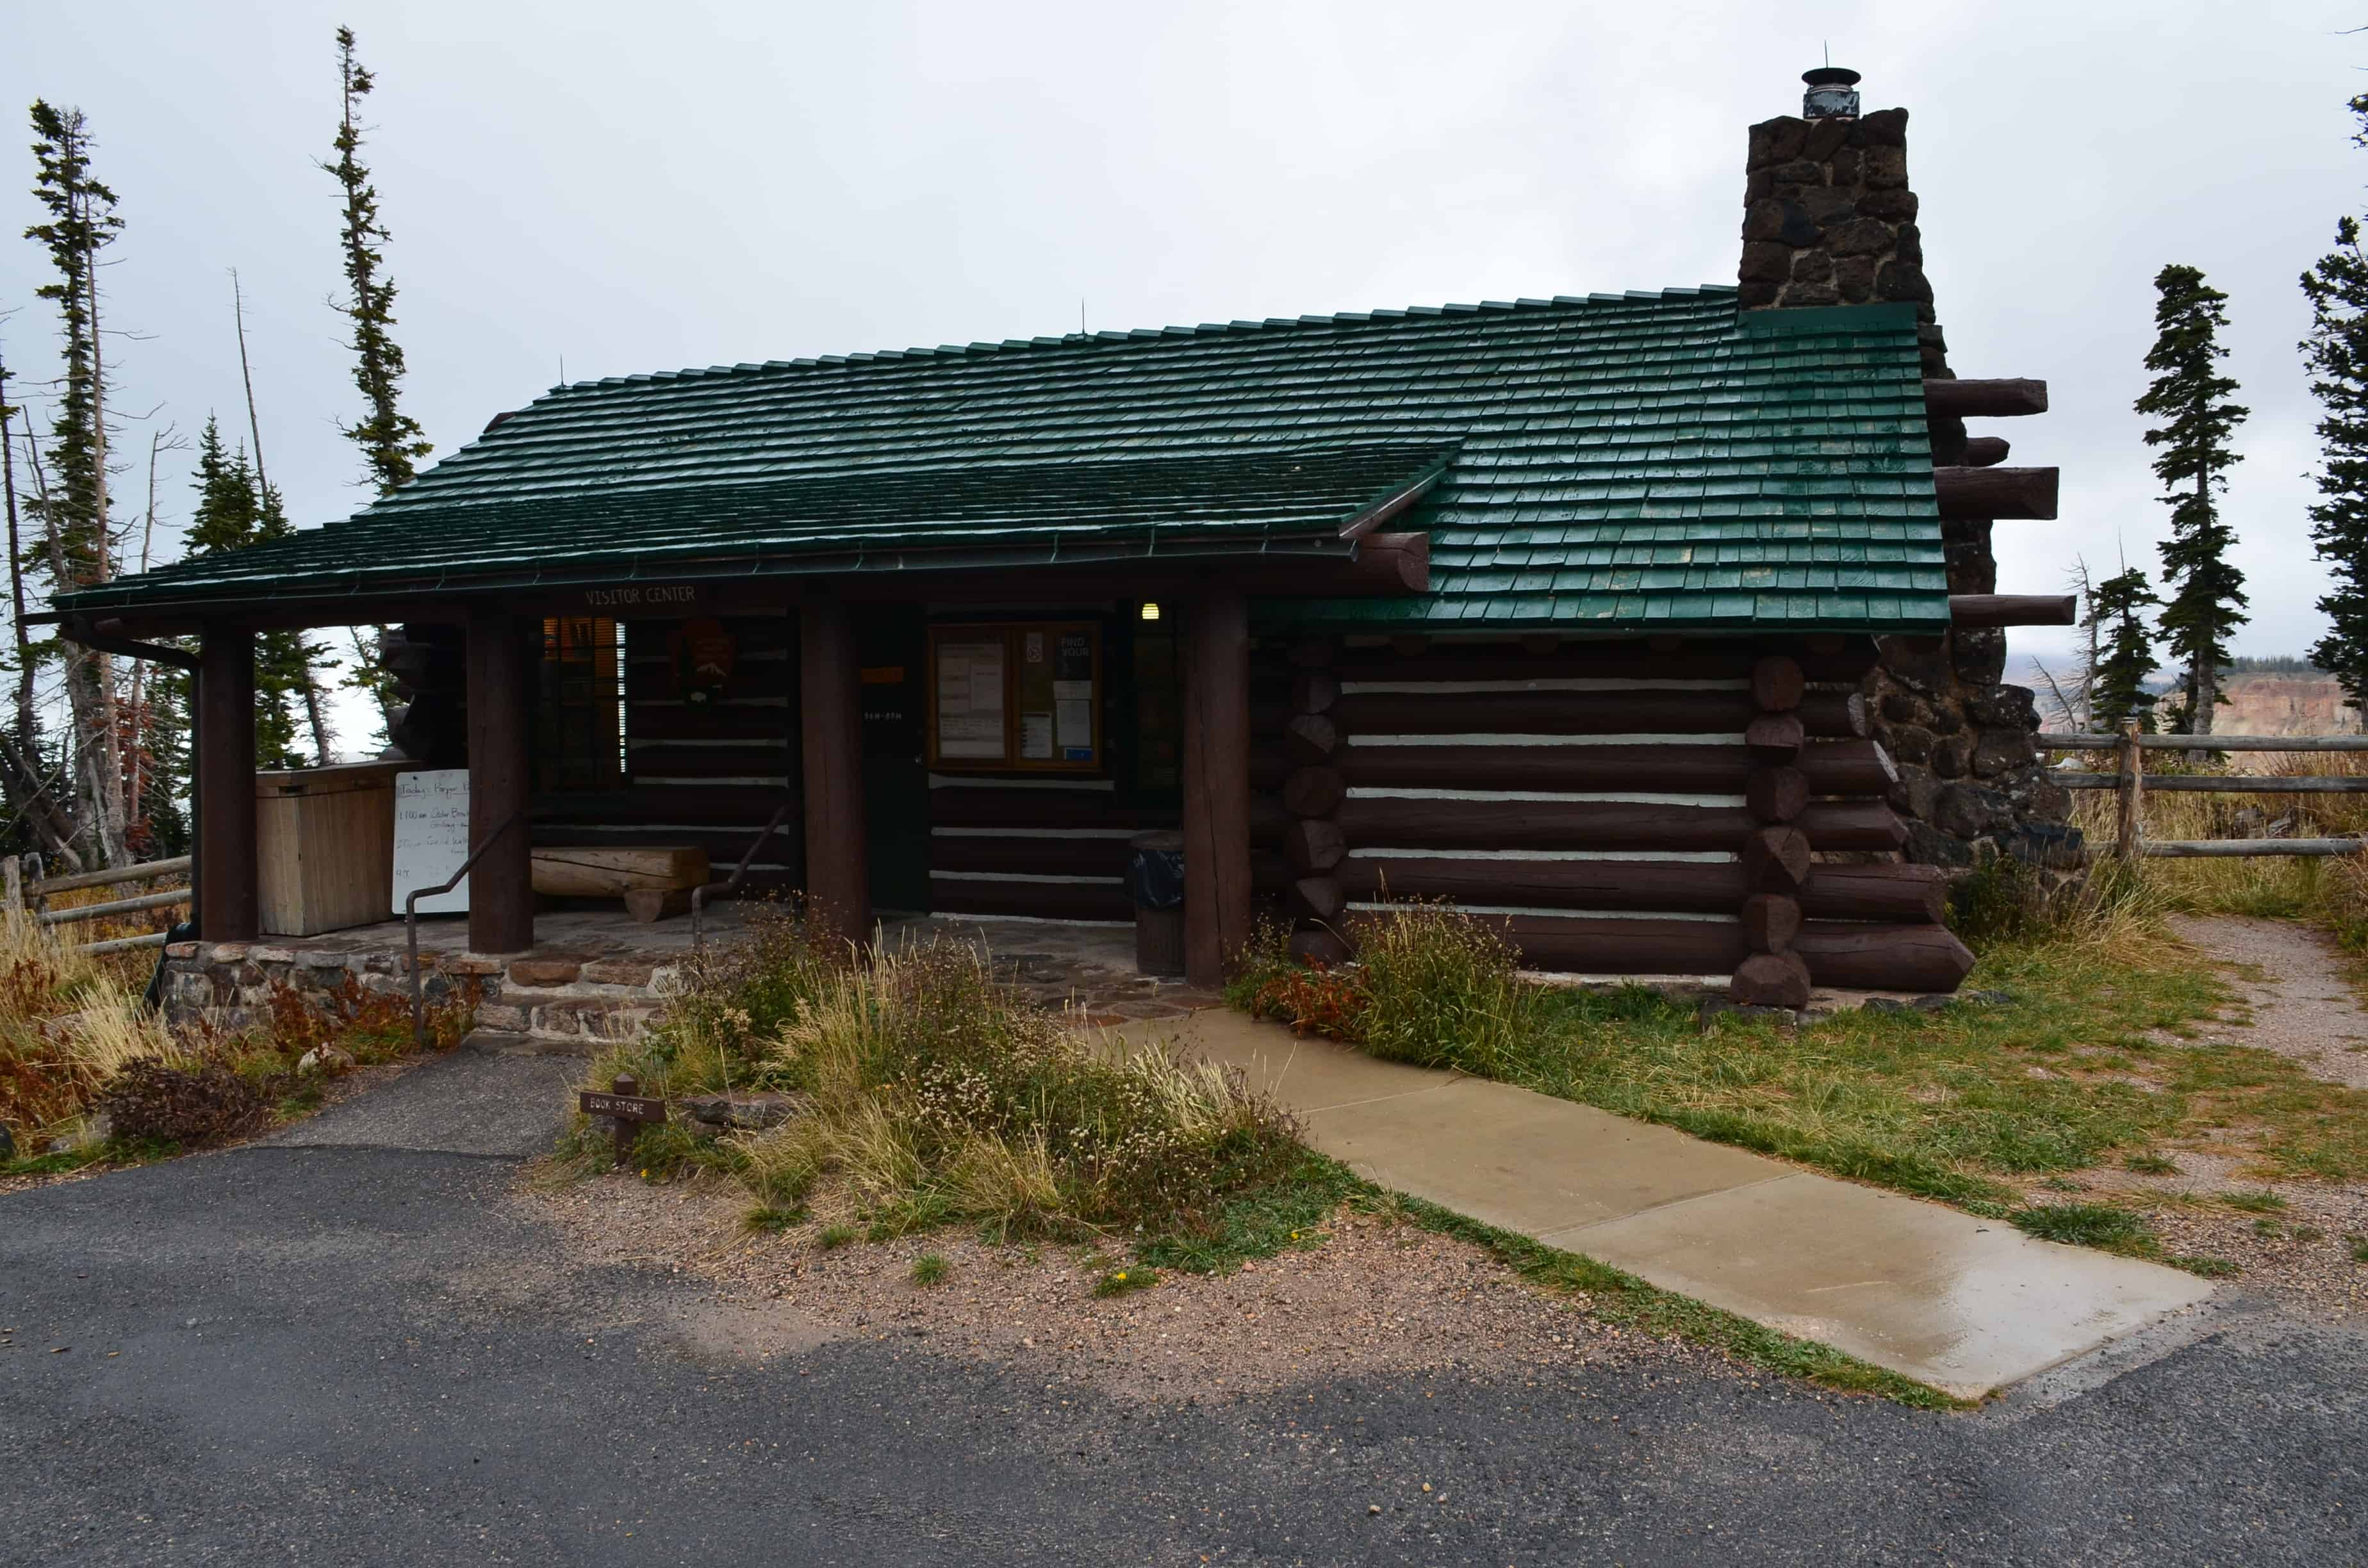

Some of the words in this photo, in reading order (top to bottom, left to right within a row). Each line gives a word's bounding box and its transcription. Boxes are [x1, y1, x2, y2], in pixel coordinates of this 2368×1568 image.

[585, 589, 641, 605] VISITOR
[646, 585, 696, 602] CENTER
[1061, 635, 1085, 646] FIND
[1061, 646, 1089, 656] YOUR
[590, 1097, 611, 1110] BOOK
[615, 1101, 645, 1115] STORE
